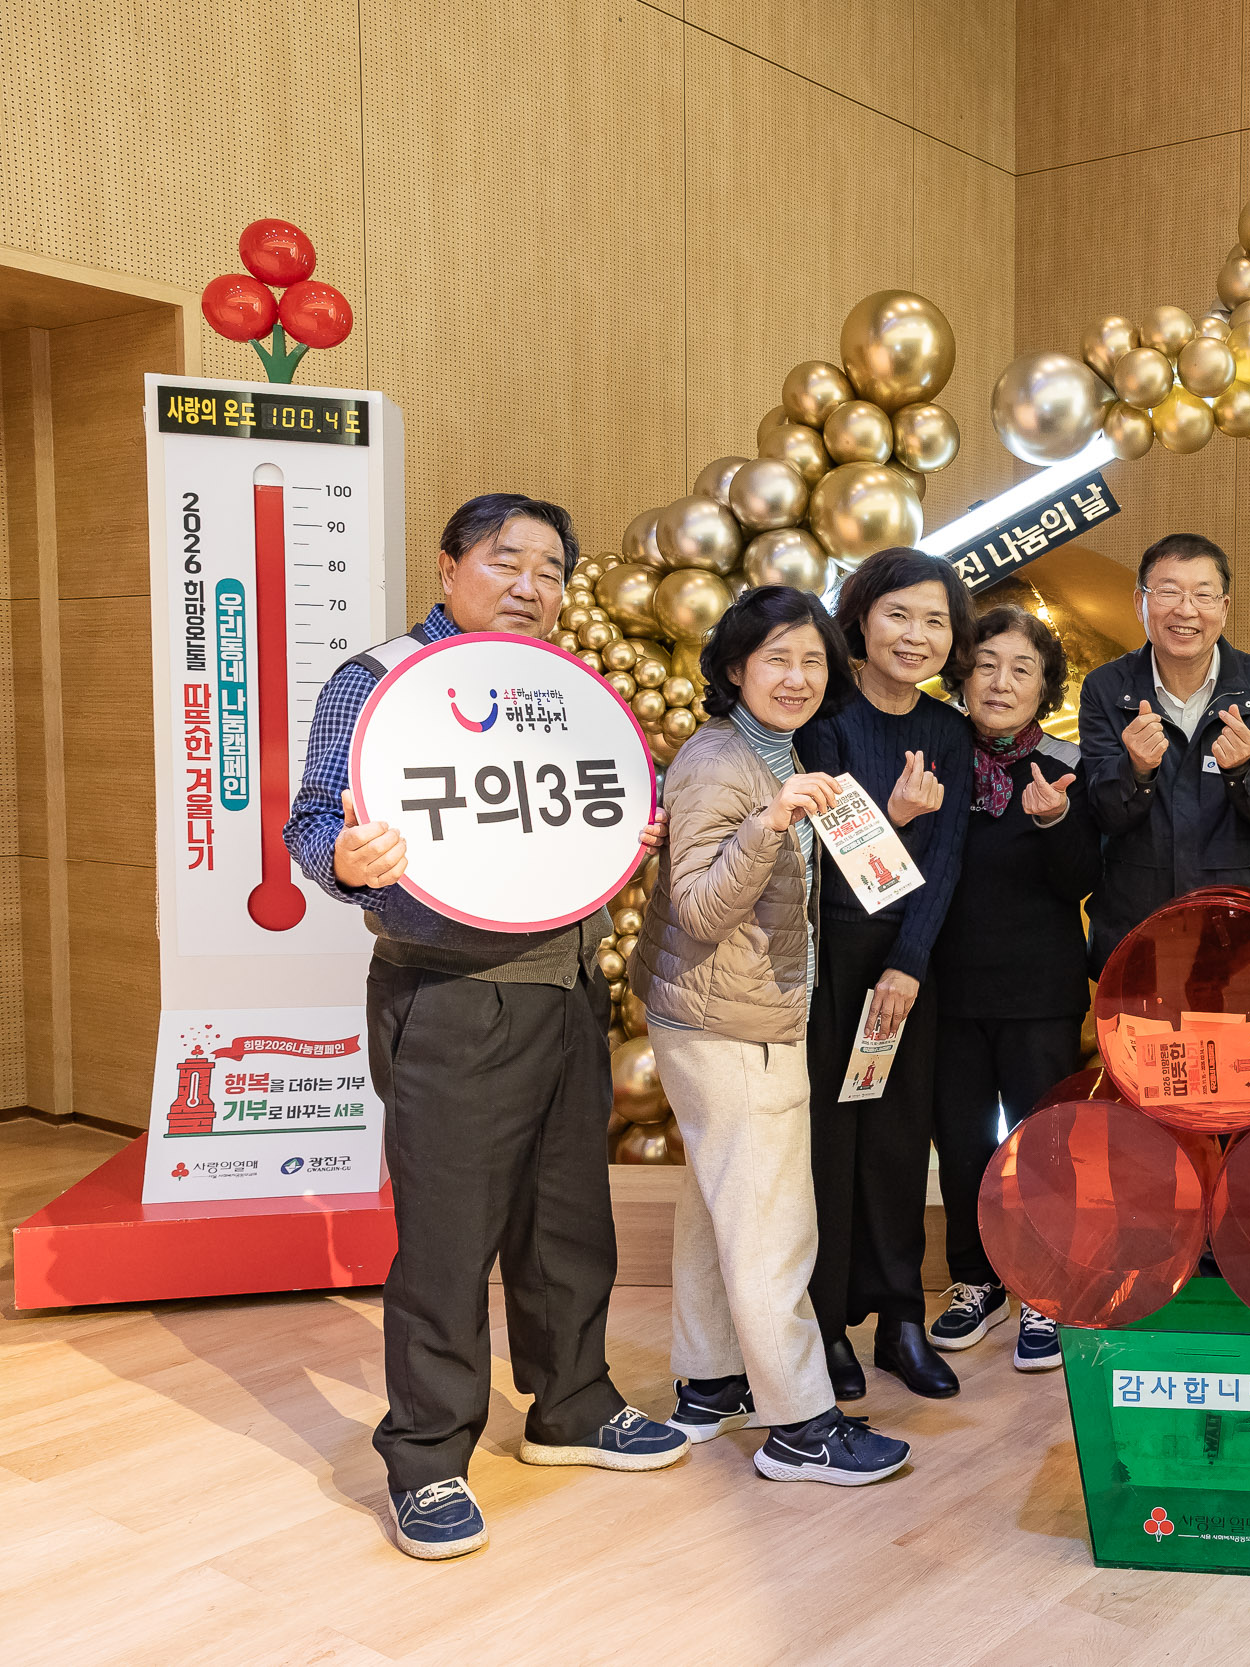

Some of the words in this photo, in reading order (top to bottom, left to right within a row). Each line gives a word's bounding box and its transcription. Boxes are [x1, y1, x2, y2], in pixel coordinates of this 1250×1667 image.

[167, 396, 217, 426] 사랑의
[223, 399, 257, 427] 온도
[325, 485, 352, 498] 100
[182, 493, 202, 574] 2026
[327, 521, 346, 534] 90
[984, 501, 1077, 567] 나눔의
[1070, 482, 1110, 522] 날
[328, 560, 346, 572] 80
[329, 599, 347, 611] 70
[184, 580, 206, 671] 희망온돌
[218, 593, 245, 683] 우리동네
[330, 638, 347, 649] 60
[503, 687, 534, 706] 소통하며
[533, 689, 564, 706] 발전하는
[183, 683, 212, 761] 따뜻한
[505, 703, 568, 733] 행복광진
[221, 689, 247, 800] 나눔캠페인
[401, 759, 626, 841] 구의3동
[820, 797, 870, 831] 따뜻한
[186, 768, 215, 871] 겨울나기
[829, 810, 876, 842] 겨울나기
[225, 1072, 284, 1095] 행복을
[288, 1078, 333, 1092] 더하는
[337, 1076, 365, 1090] 기부
[1169, 1042, 1188, 1096] 따뜻한
[223, 1099, 282, 1121] 기부로
[286, 1104, 331, 1119] 바꾸는
[334, 1103, 364, 1117] 서울
[306, 1165, 351, 1173] GWANGJIN-GU
[308, 1155, 352, 1167] 광진구
